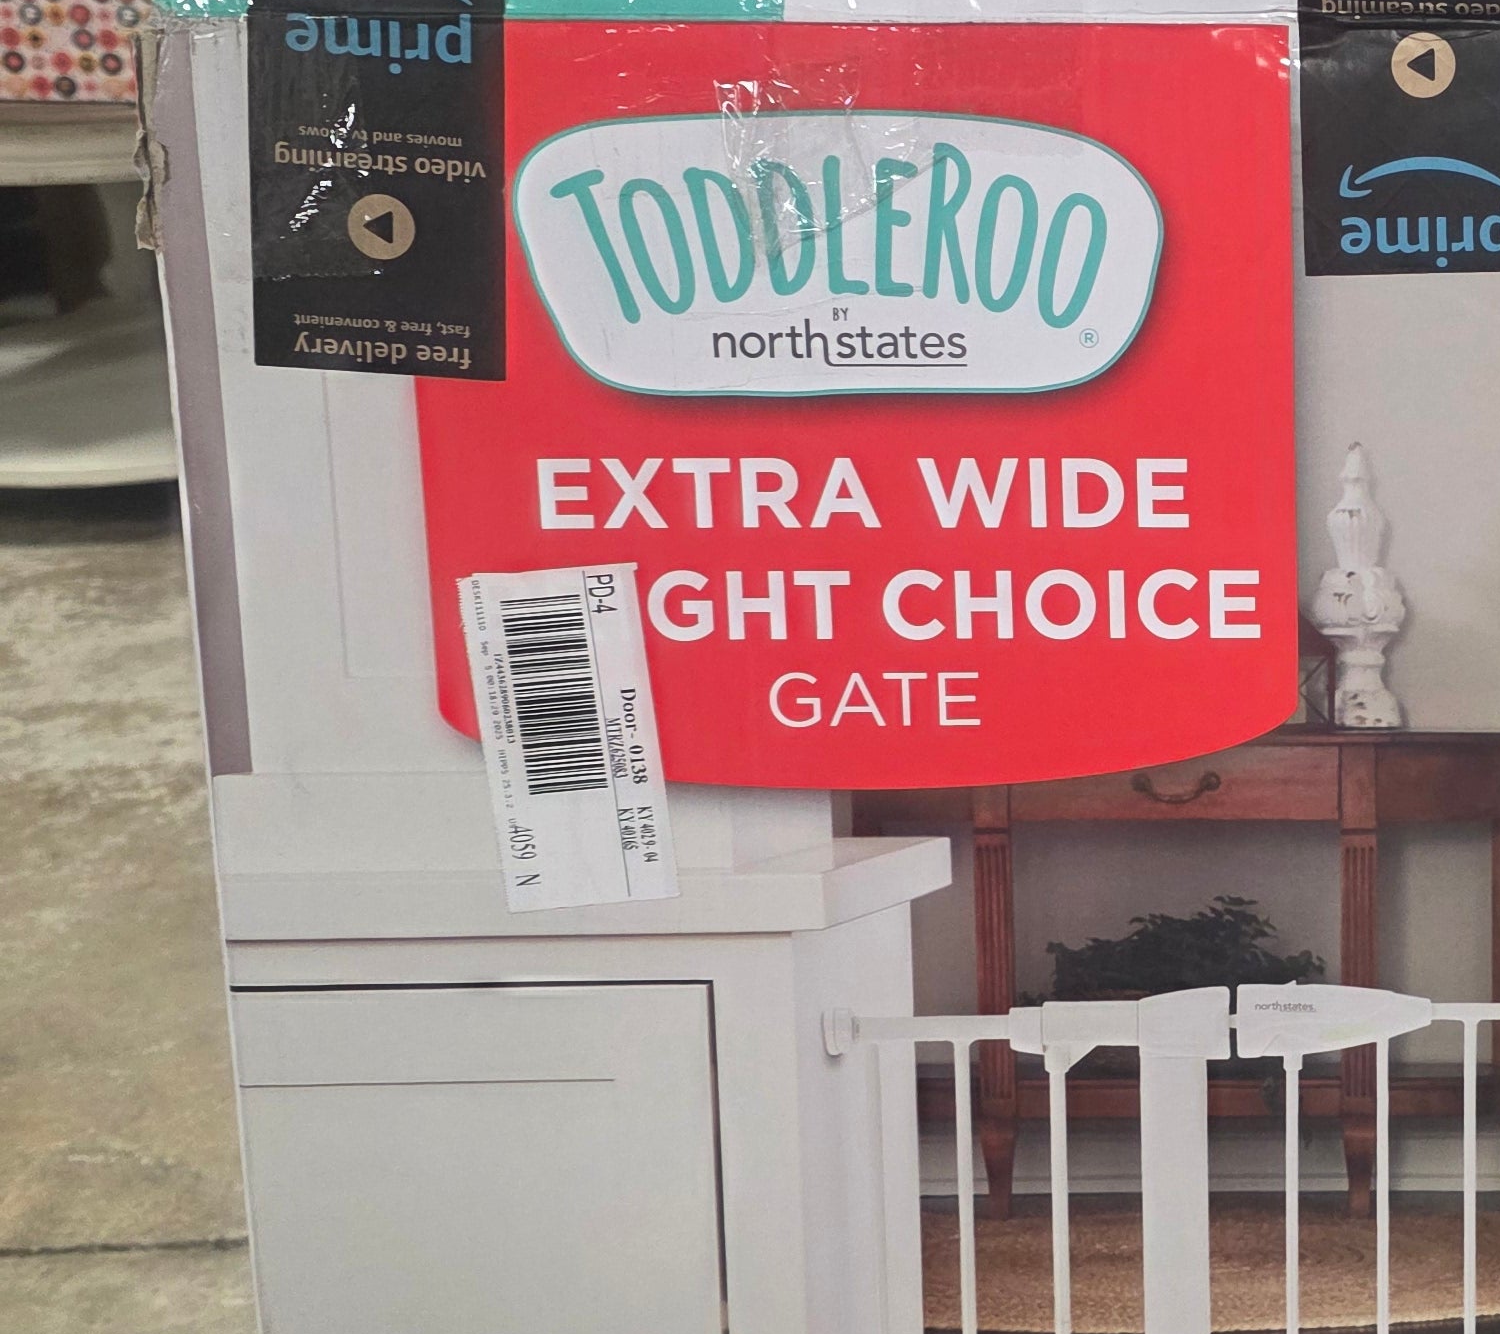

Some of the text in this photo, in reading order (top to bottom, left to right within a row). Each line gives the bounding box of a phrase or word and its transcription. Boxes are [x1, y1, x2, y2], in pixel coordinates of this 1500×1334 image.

[285, 12, 474, 74] prime
[351, 129, 369, 142] tv
[372, 131, 402, 144] and
[406, 132, 463, 149] movies
[273, 140, 487, 183] video streaming
[549, 141, 1108, 328] TODDLEROO
[293, 313, 380, 330] convenient
[400, 320, 433, 337] free
[435, 320, 471, 339] fast,
[832, 307, 850, 321] BY
[293, 331, 473, 371] free delivery
[711, 320, 968, 361] northstates
[538, 457, 1190, 529] EXTRA WIDE
[586, 573, 618, 615] PD-4
[881, 569, 1261, 640] CHOICE
[768, 670, 982, 729] GATE
[629, 744, 649, 785] 0138
[510, 822, 542, 887] 4059 N
